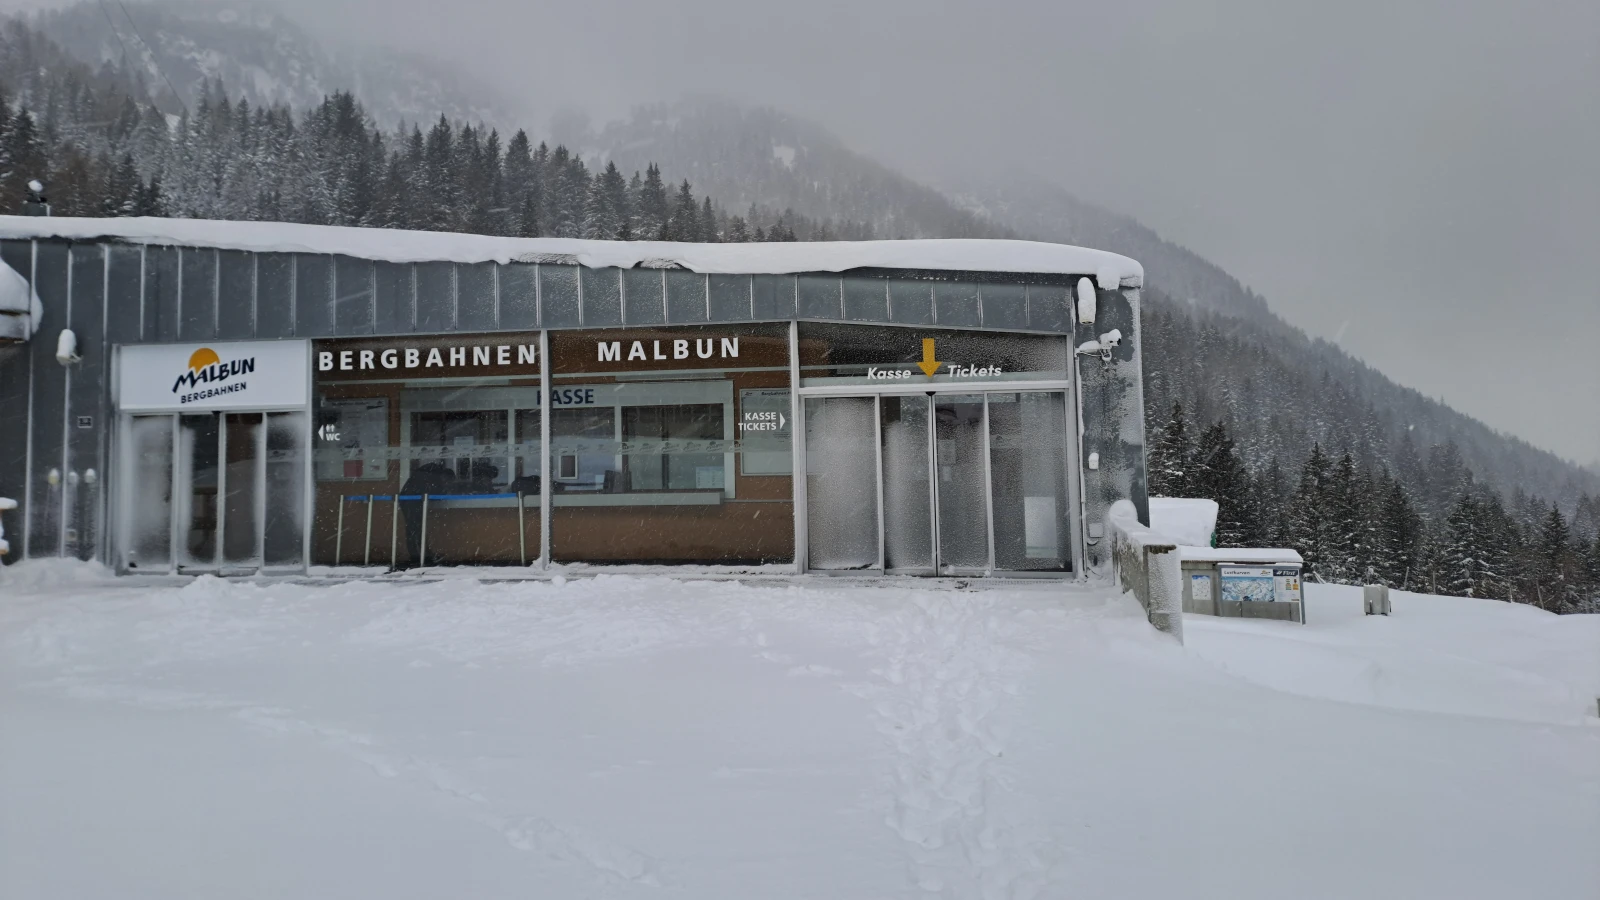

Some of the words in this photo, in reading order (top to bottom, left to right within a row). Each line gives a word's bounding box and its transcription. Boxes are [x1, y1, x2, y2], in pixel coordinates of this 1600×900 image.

[318, 344, 535, 371] BERGBAHNEN
[597, 337, 739, 362] MALBUN
[172, 357, 255, 394] MALBUN
[867, 367, 912, 380] Kasse
[948, 364, 1002, 378] Tickets
[181, 381, 247, 404] BERGBAHNEN
[745, 412, 777, 421] KASSE
[738, 422, 777, 431] TICKETS
[325, 433, 341, 441] WC
